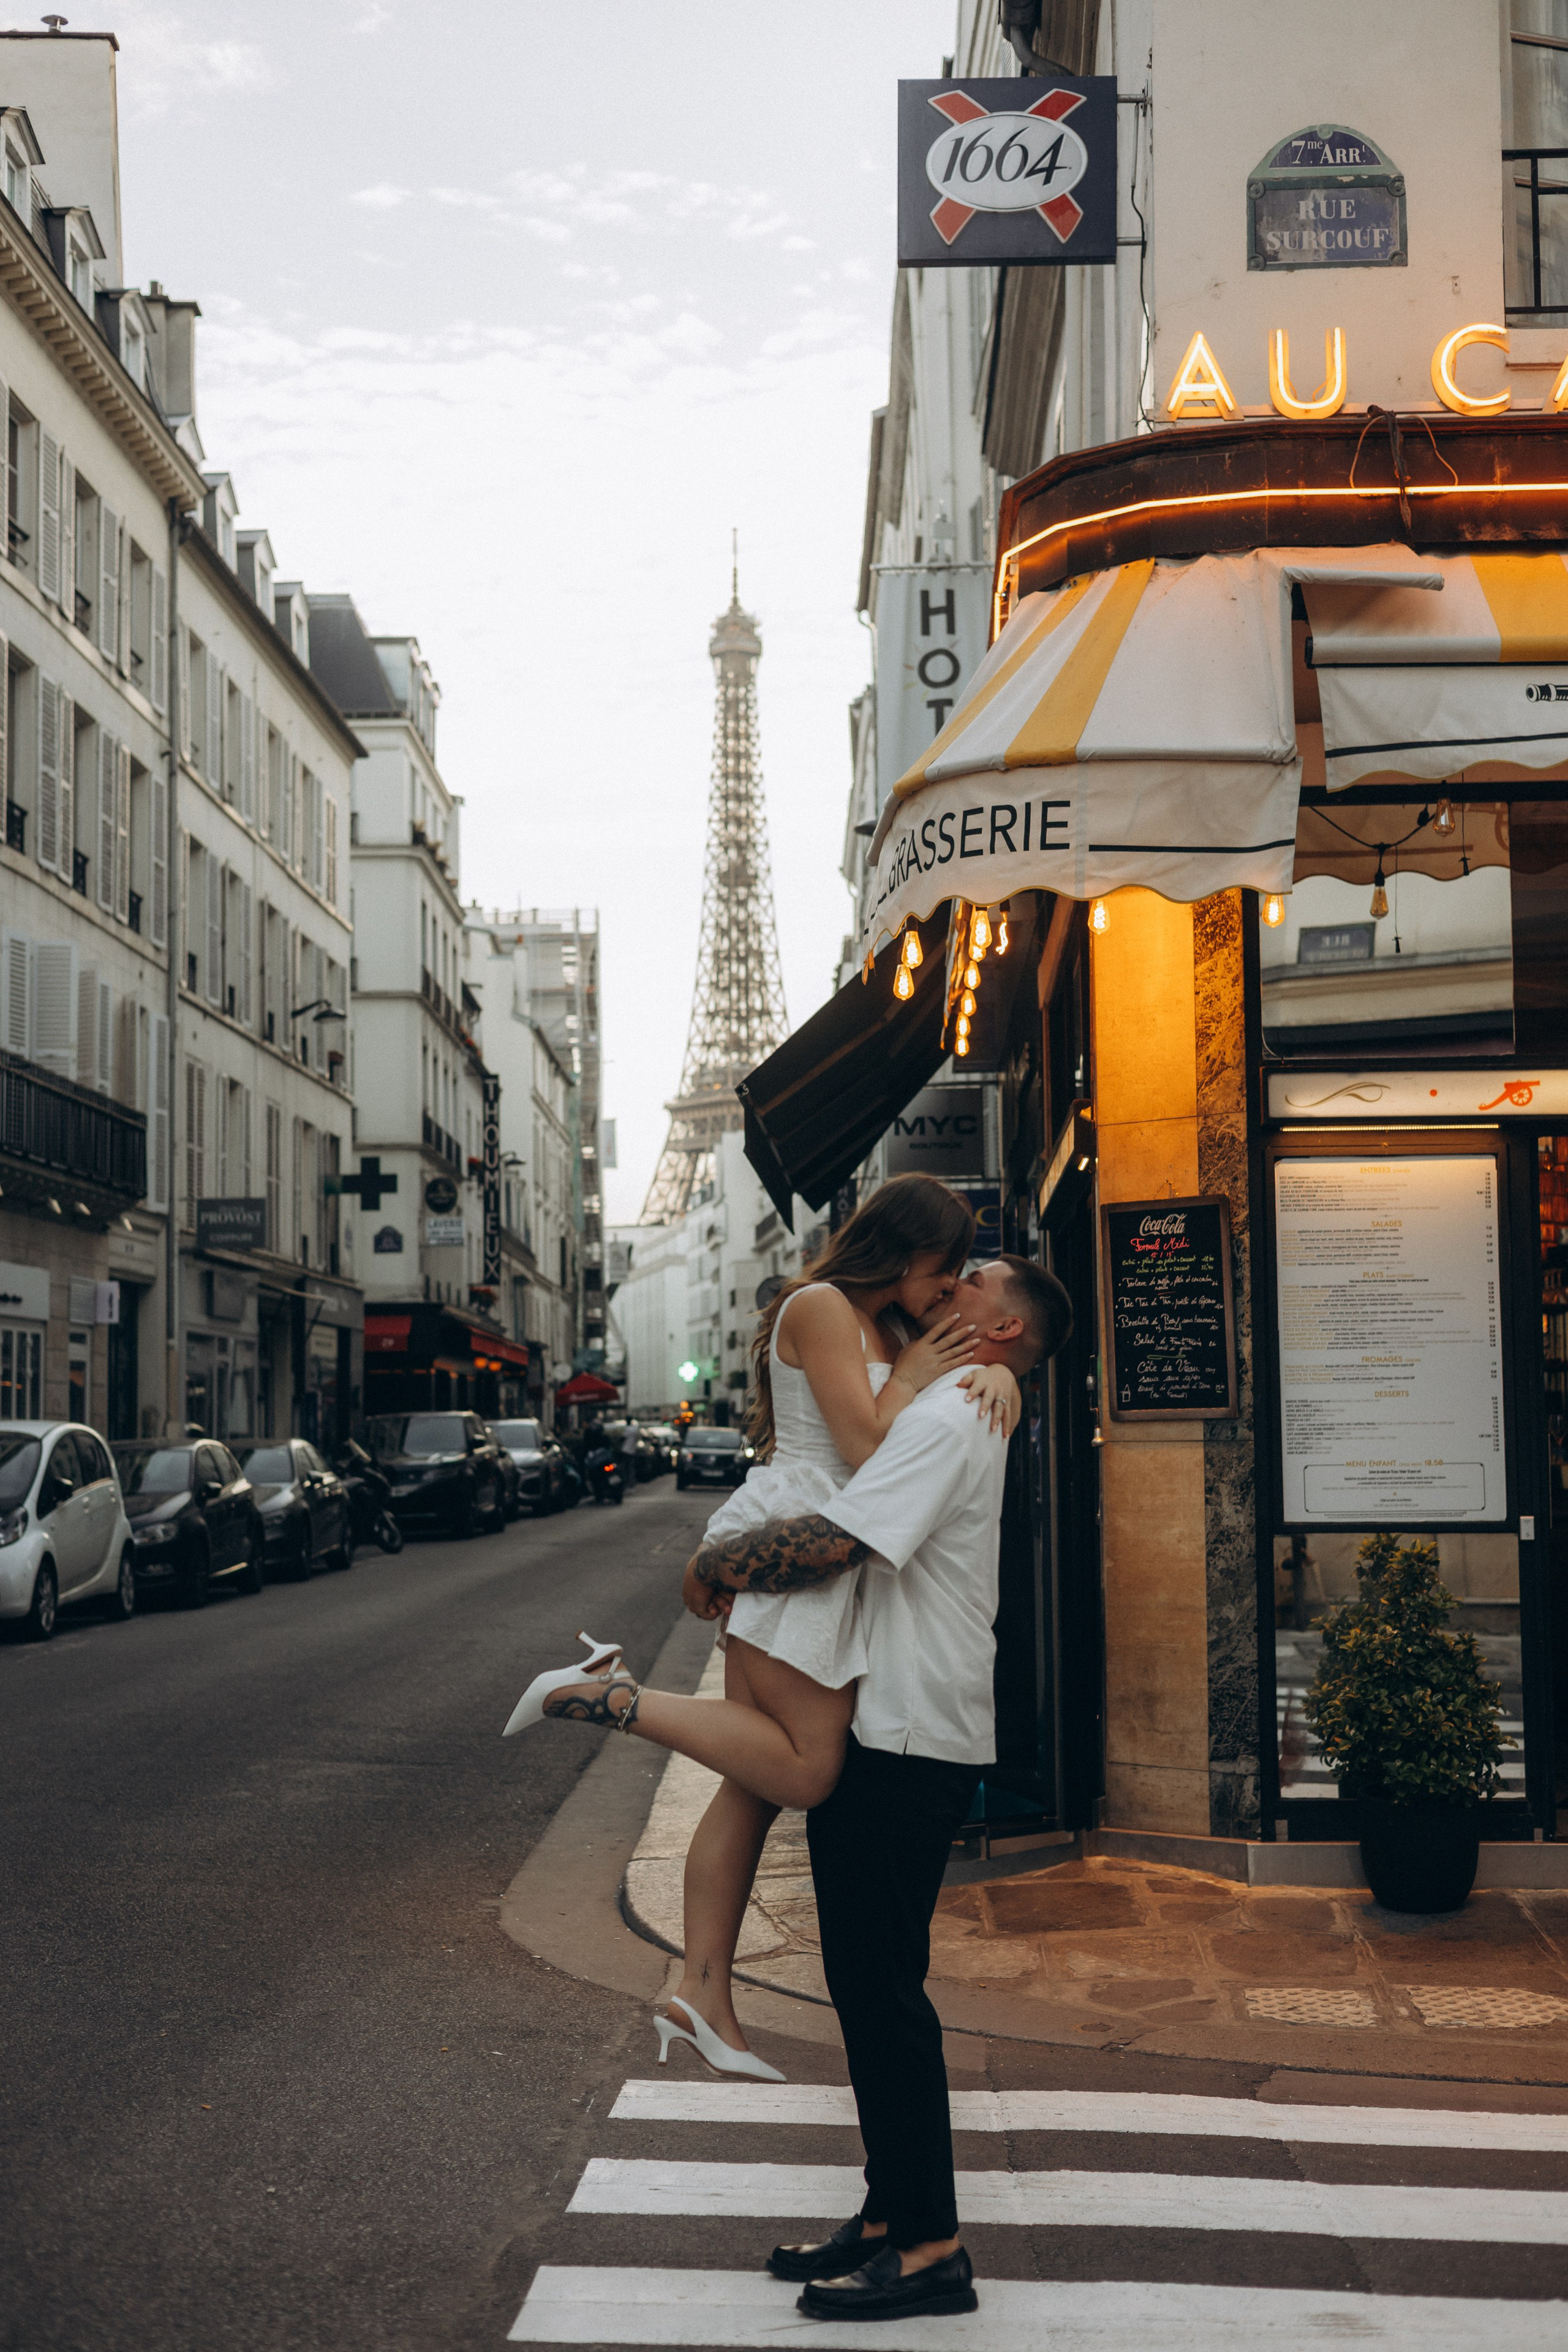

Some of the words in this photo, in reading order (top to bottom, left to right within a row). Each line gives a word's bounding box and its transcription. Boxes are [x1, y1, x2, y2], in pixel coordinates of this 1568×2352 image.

[942, 126, 1068, 186] 1664
[1298, 199, 1356, 220] RUE
[1266, 228, 1389, 251] SURCOUF
[1155, 327, 1346, 422] AU
[889, 801, 1071, 894] BRASSERIE
[485, 1079, 499, 1279] THOUMIEUX
[201, 1211, 261, 1225] PROVOST
[1139, 1213, 1188, 1236] Coca-Cola
[1130, 1238, 1159, 1252] Formule
[1163, 1237, 1189, 1250] Midi
[1137, 1360, 1157, 1374] Côte
[1161, 1360, 1172, 1371] de
[1175, 1359, 1200, 1372] Veau
